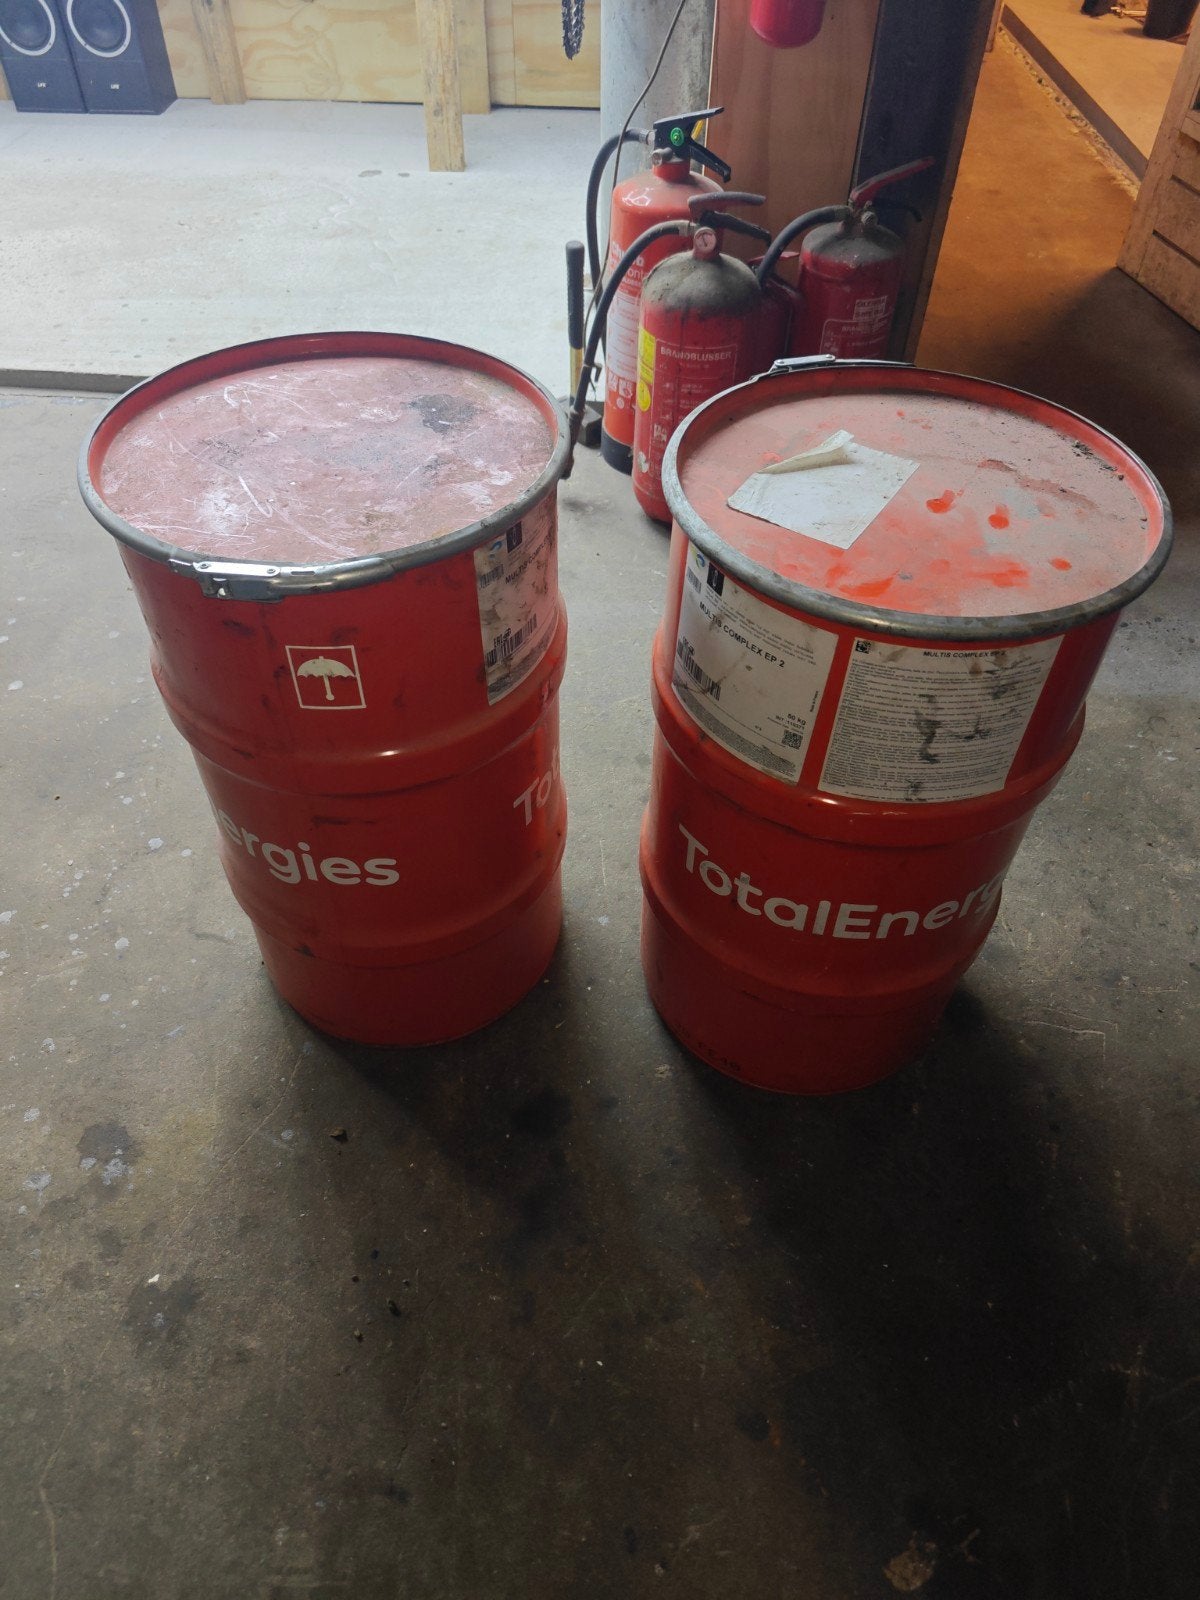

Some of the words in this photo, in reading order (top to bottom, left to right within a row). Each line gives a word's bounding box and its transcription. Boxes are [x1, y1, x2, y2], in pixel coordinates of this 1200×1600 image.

[660, 346, 733, 361] BRANDBLUSSER
[699, 600, 723, 628] MULTIS
[722, 623, 763, 657] COMPLEX
[763, 651, 778, 664] EP
[778, 659, 786, 668] 2
[922, 650, 951, 658] MULTIS
